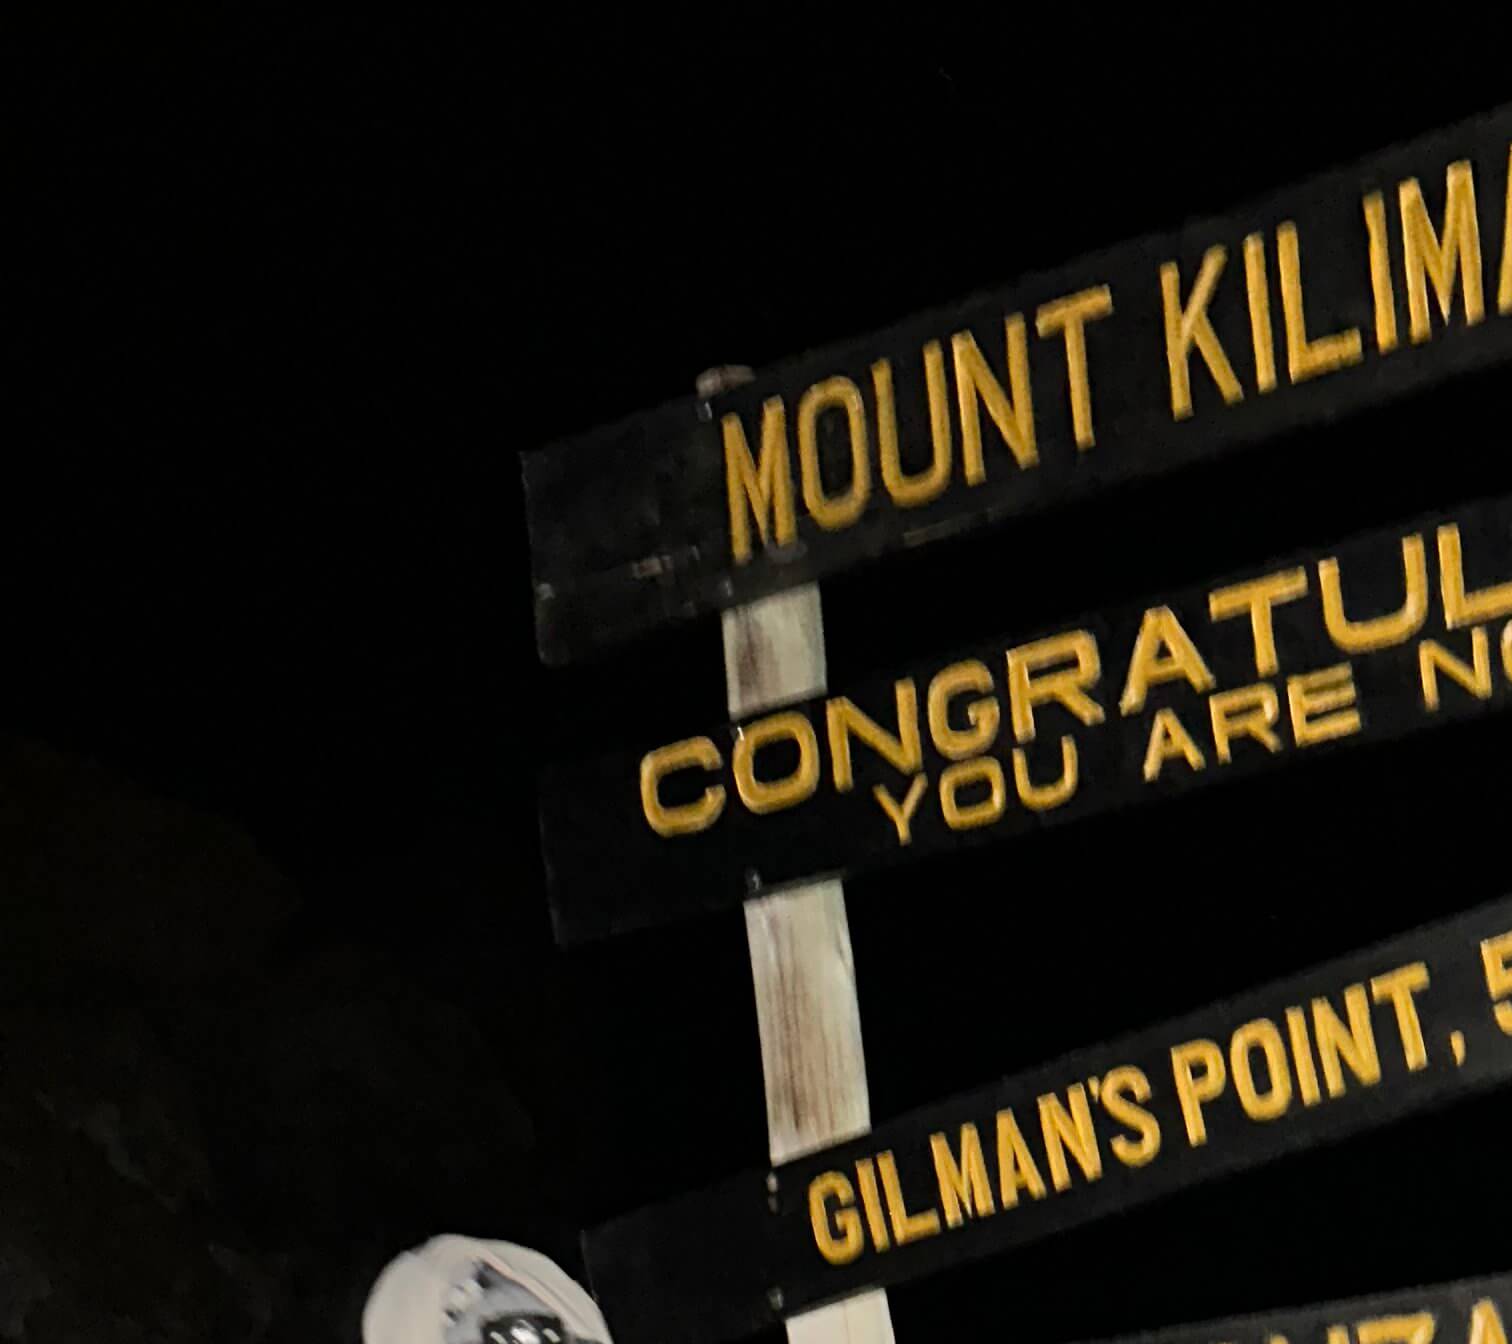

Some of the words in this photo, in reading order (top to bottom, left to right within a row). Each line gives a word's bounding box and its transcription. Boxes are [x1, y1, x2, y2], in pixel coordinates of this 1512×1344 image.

[722, 287, 1112, 562] MOUNT
[876, 736, 1078, 846] YOU
[1143, 663, 1361, 782] ARE
[808, 1065, 1161, 1266] GILMAN'S
[1170, 962, 1467, 1148] POINT,
